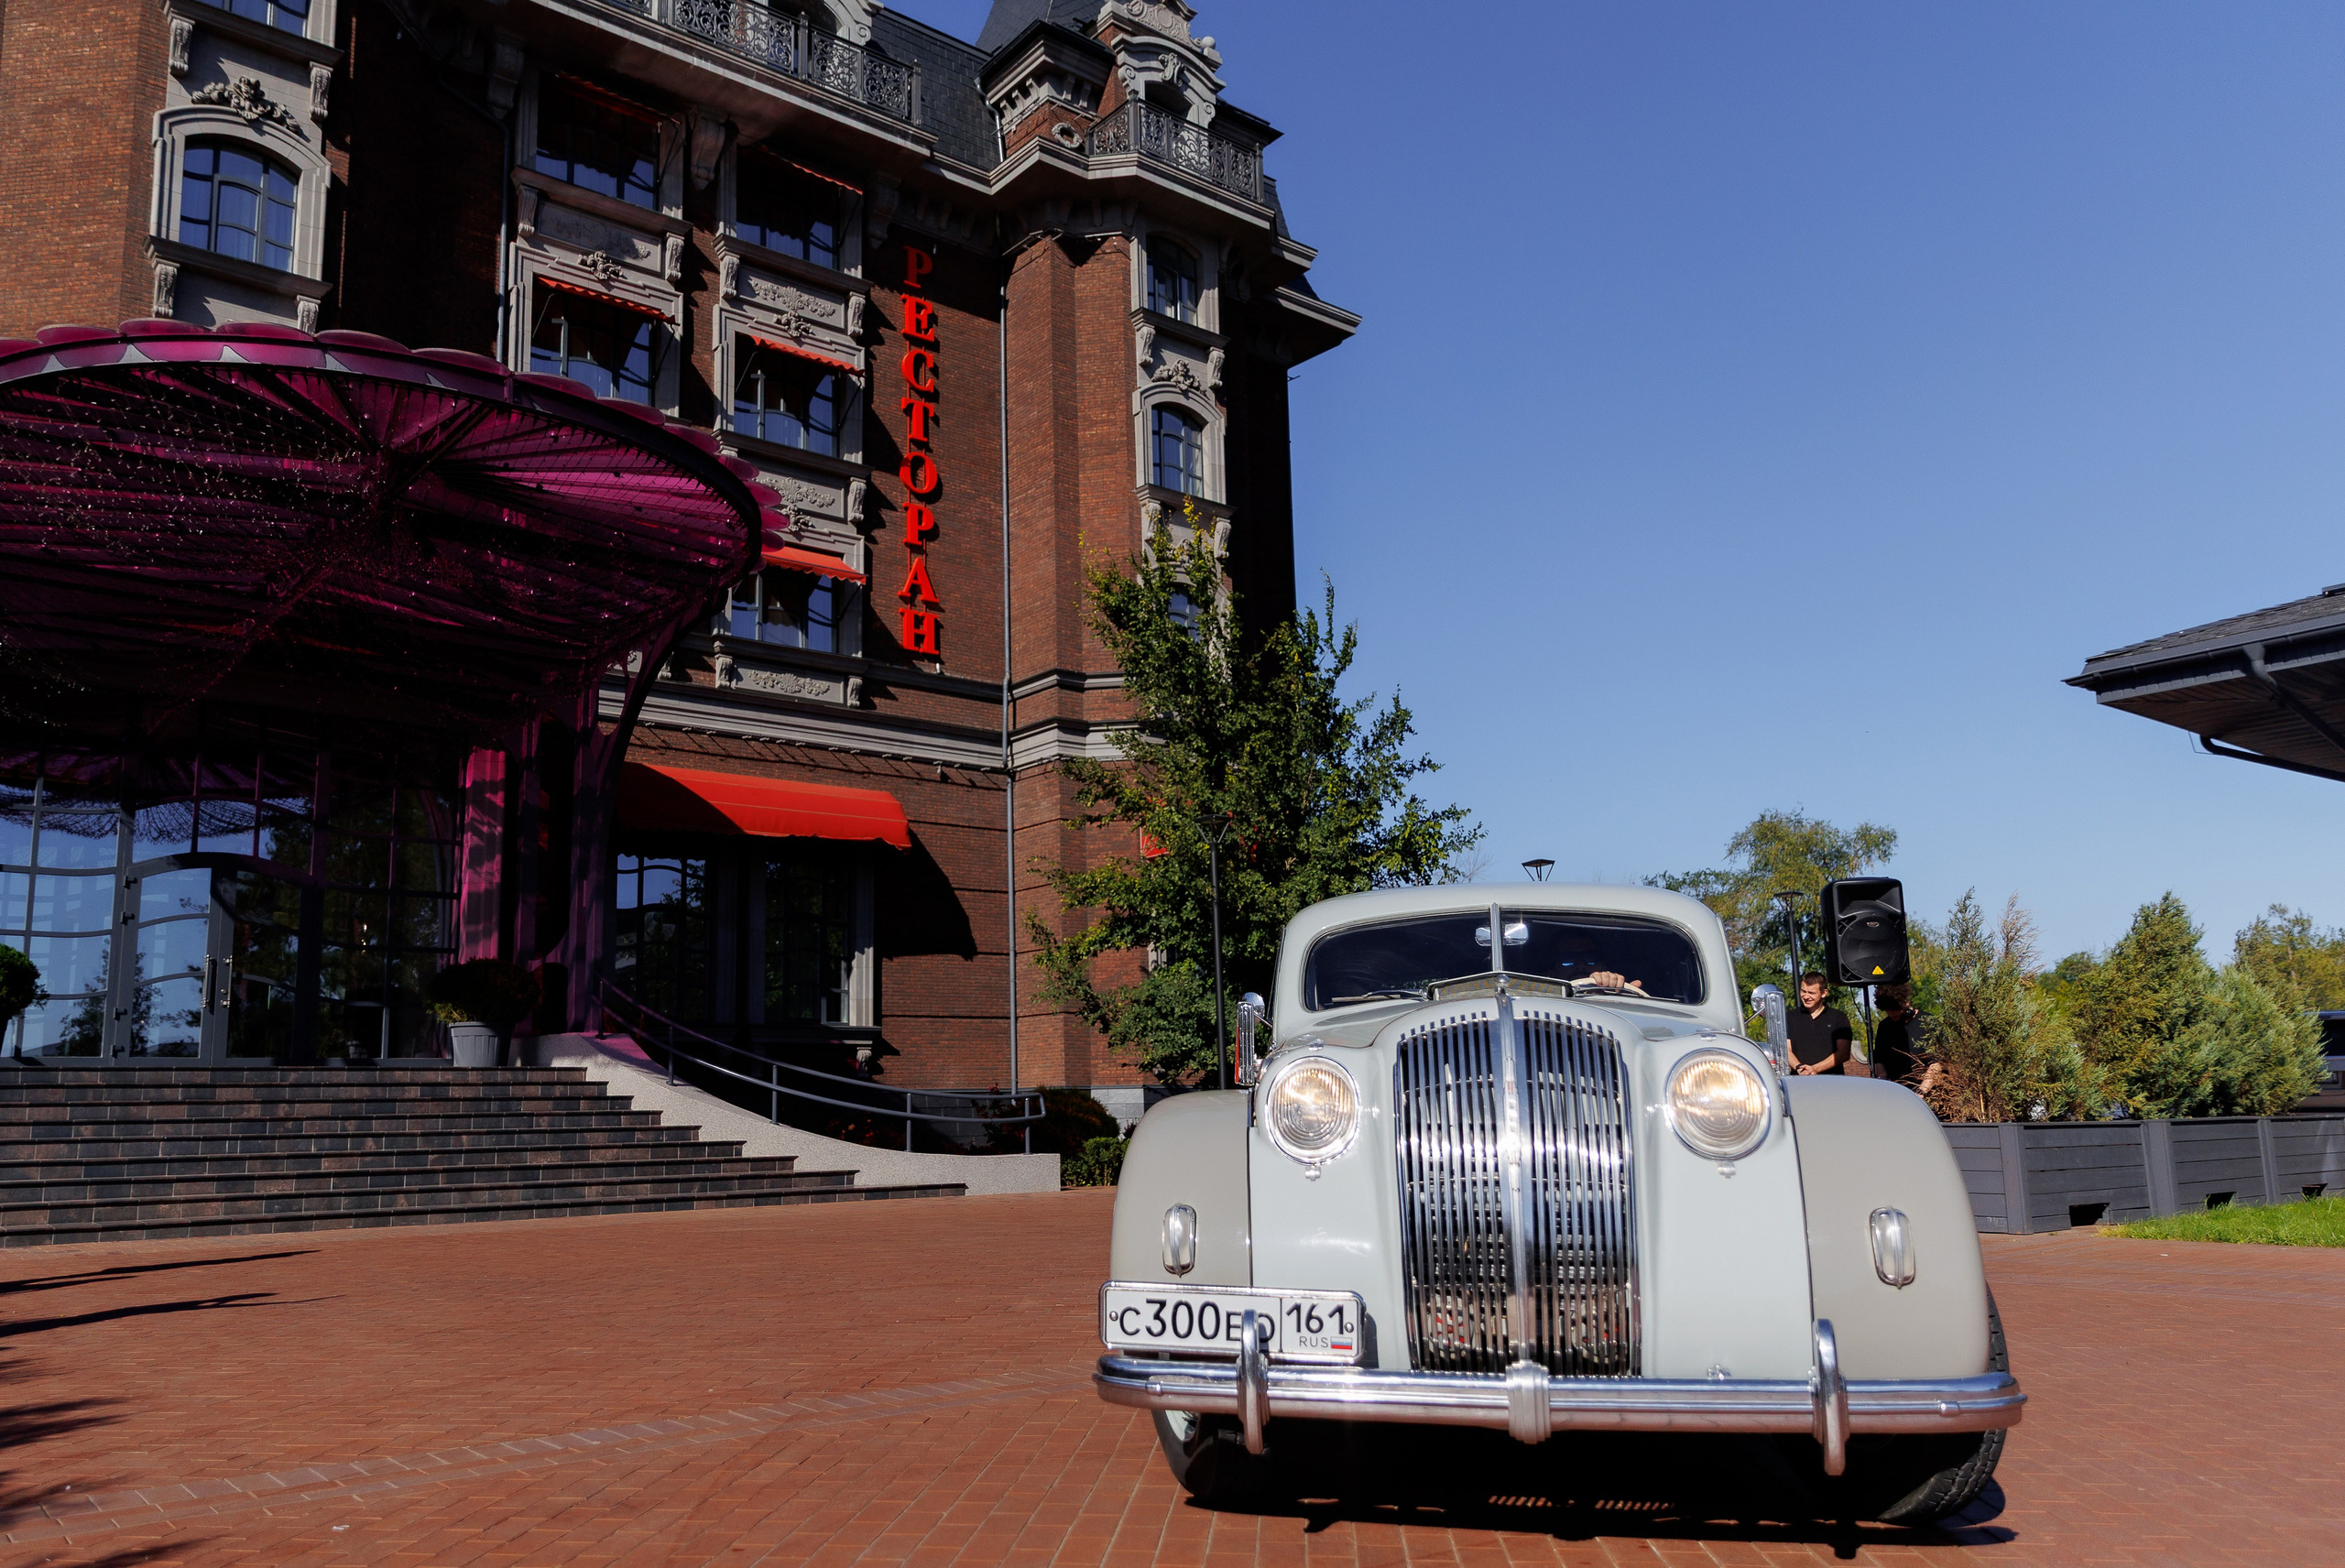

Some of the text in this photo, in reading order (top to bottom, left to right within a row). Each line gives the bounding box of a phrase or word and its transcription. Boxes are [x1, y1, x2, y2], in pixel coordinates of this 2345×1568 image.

[899, 245, 939, 655] РЕСТОРАН
[1286, 1301, 1344, 1334] 161
[1299, 1336, 1328, 1348] RUS
